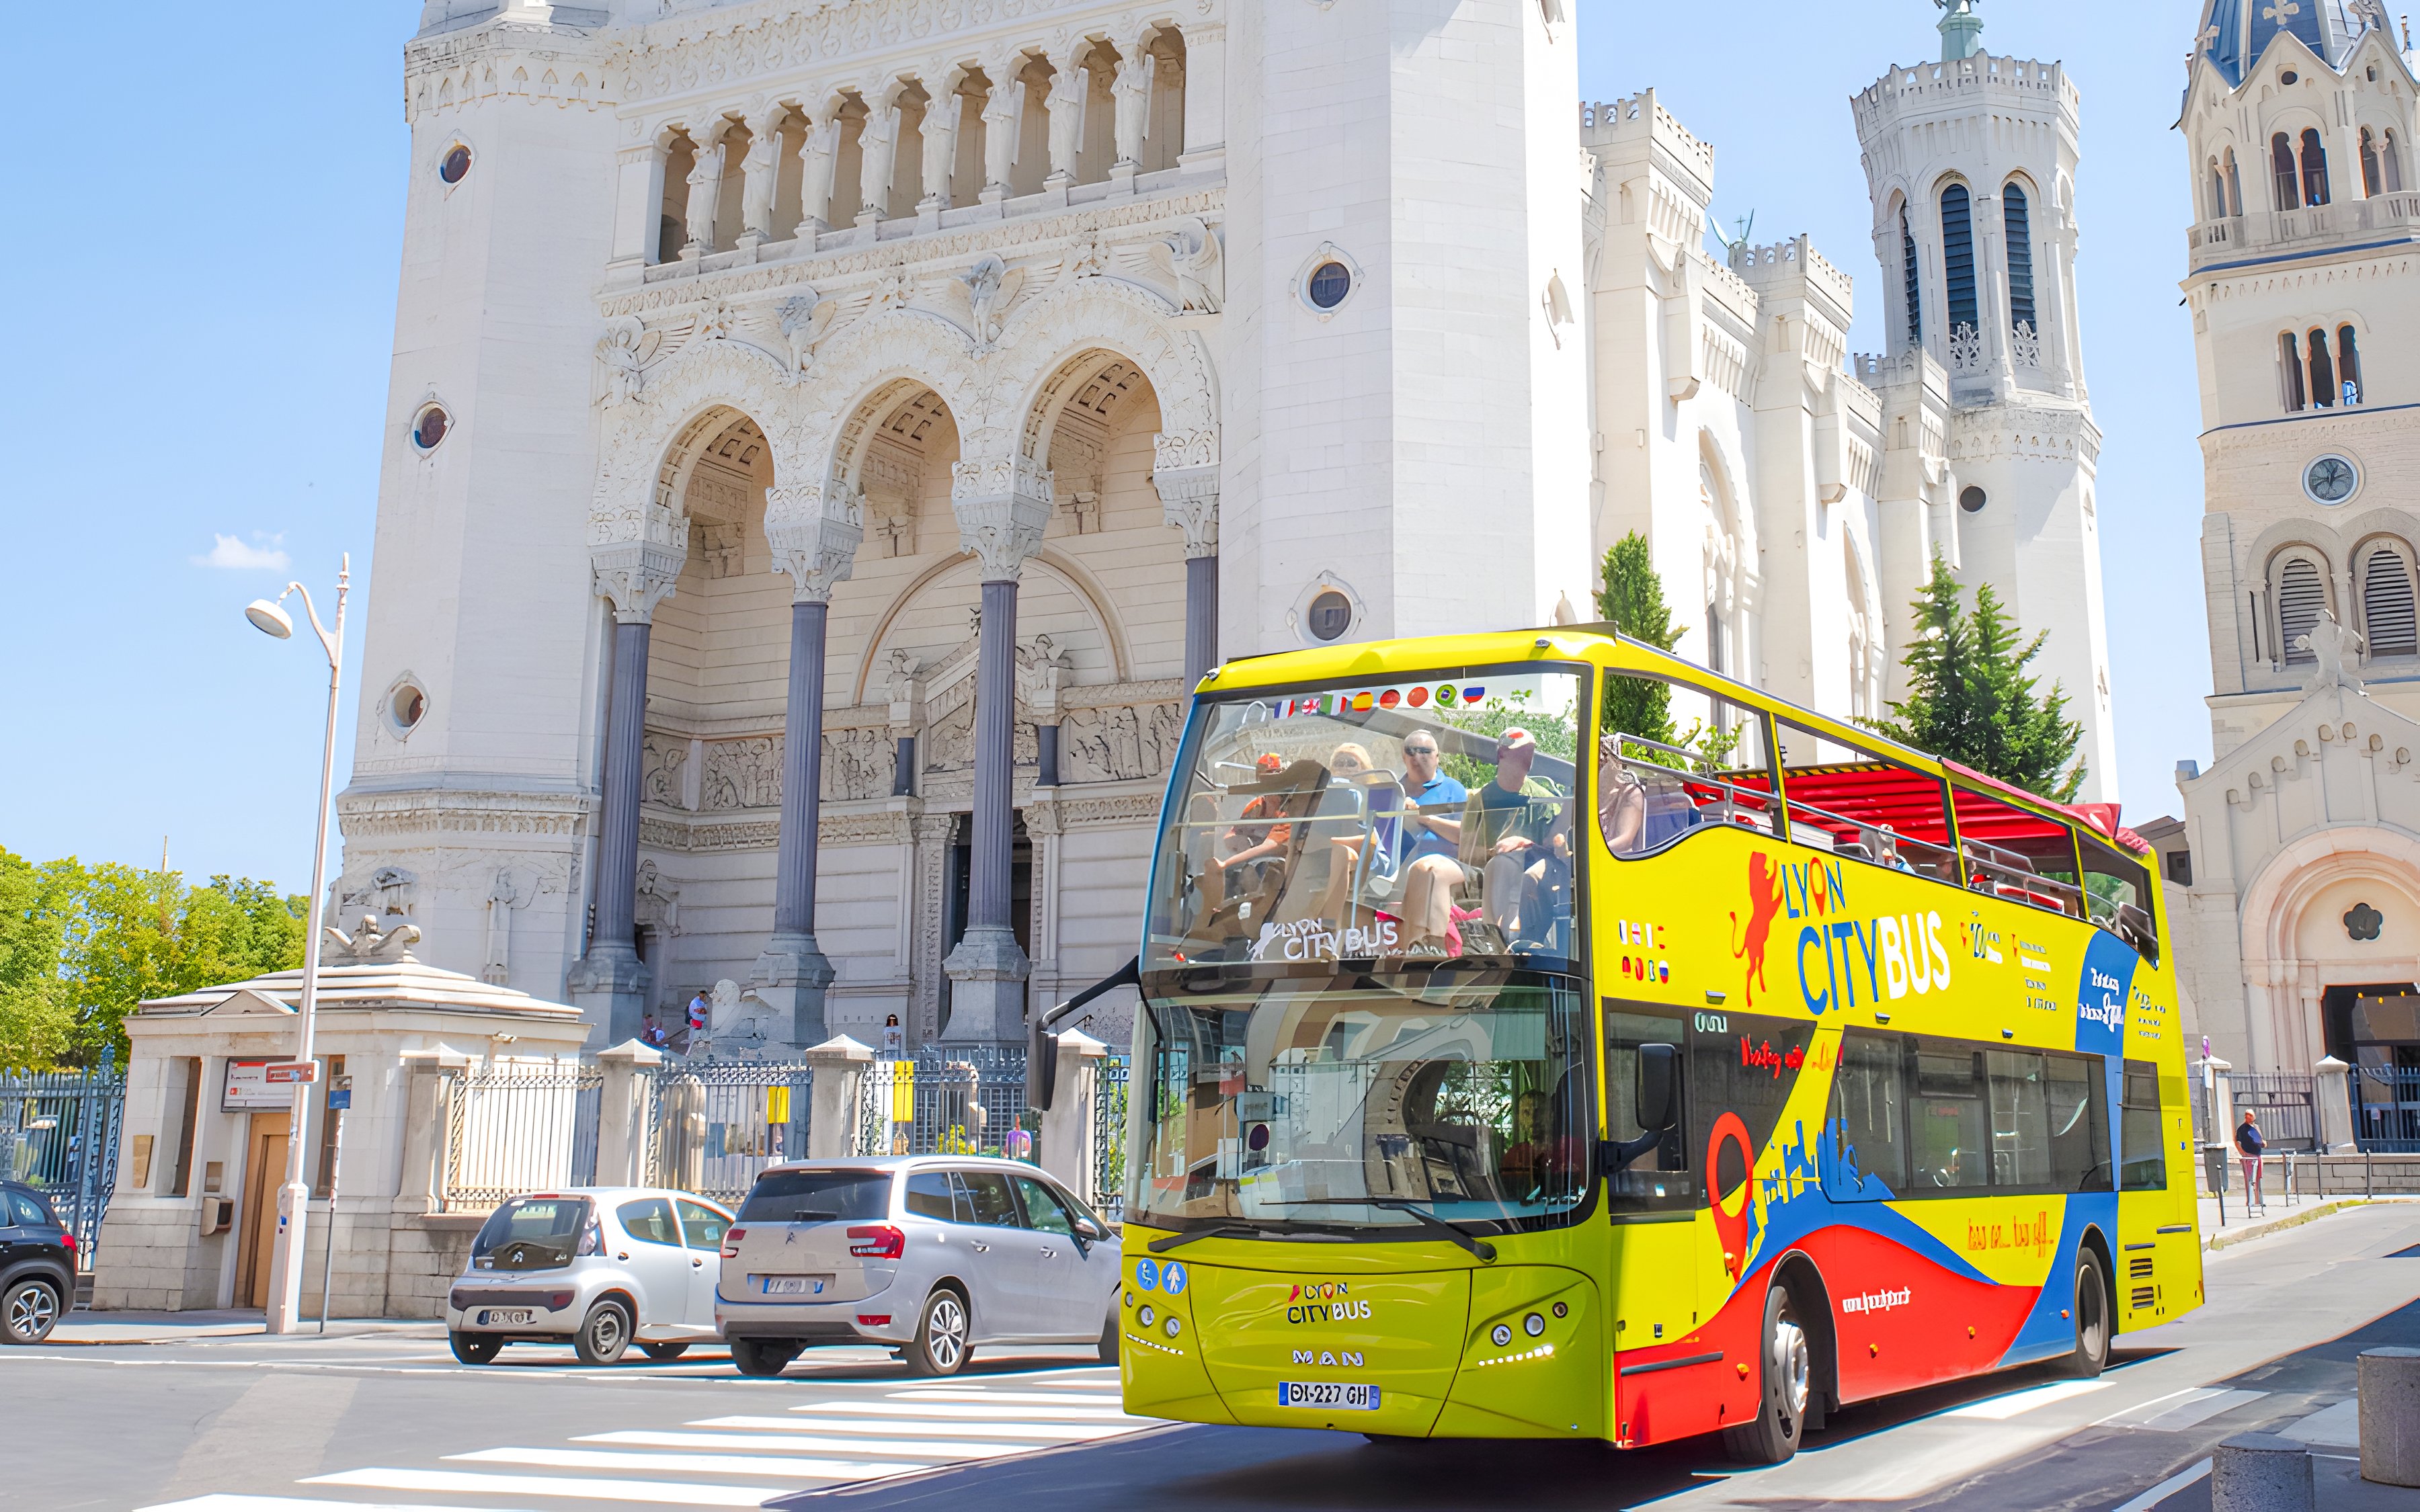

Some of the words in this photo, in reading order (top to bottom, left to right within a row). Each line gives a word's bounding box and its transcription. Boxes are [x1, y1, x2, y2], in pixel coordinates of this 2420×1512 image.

[1781, 857, 1846, 919] LYON
[1281, 918, 1323, 937] LYON
[1284, 921, 1398, 960] CITYBUS
[1798, 911, 1951, 1015] CITYBUS
[1305, 1282, 1348, 1299] LYON
[1287, 1300, 1372, 1324] CITYBUS
[1292, 1349, 1364, 1366] MAN
